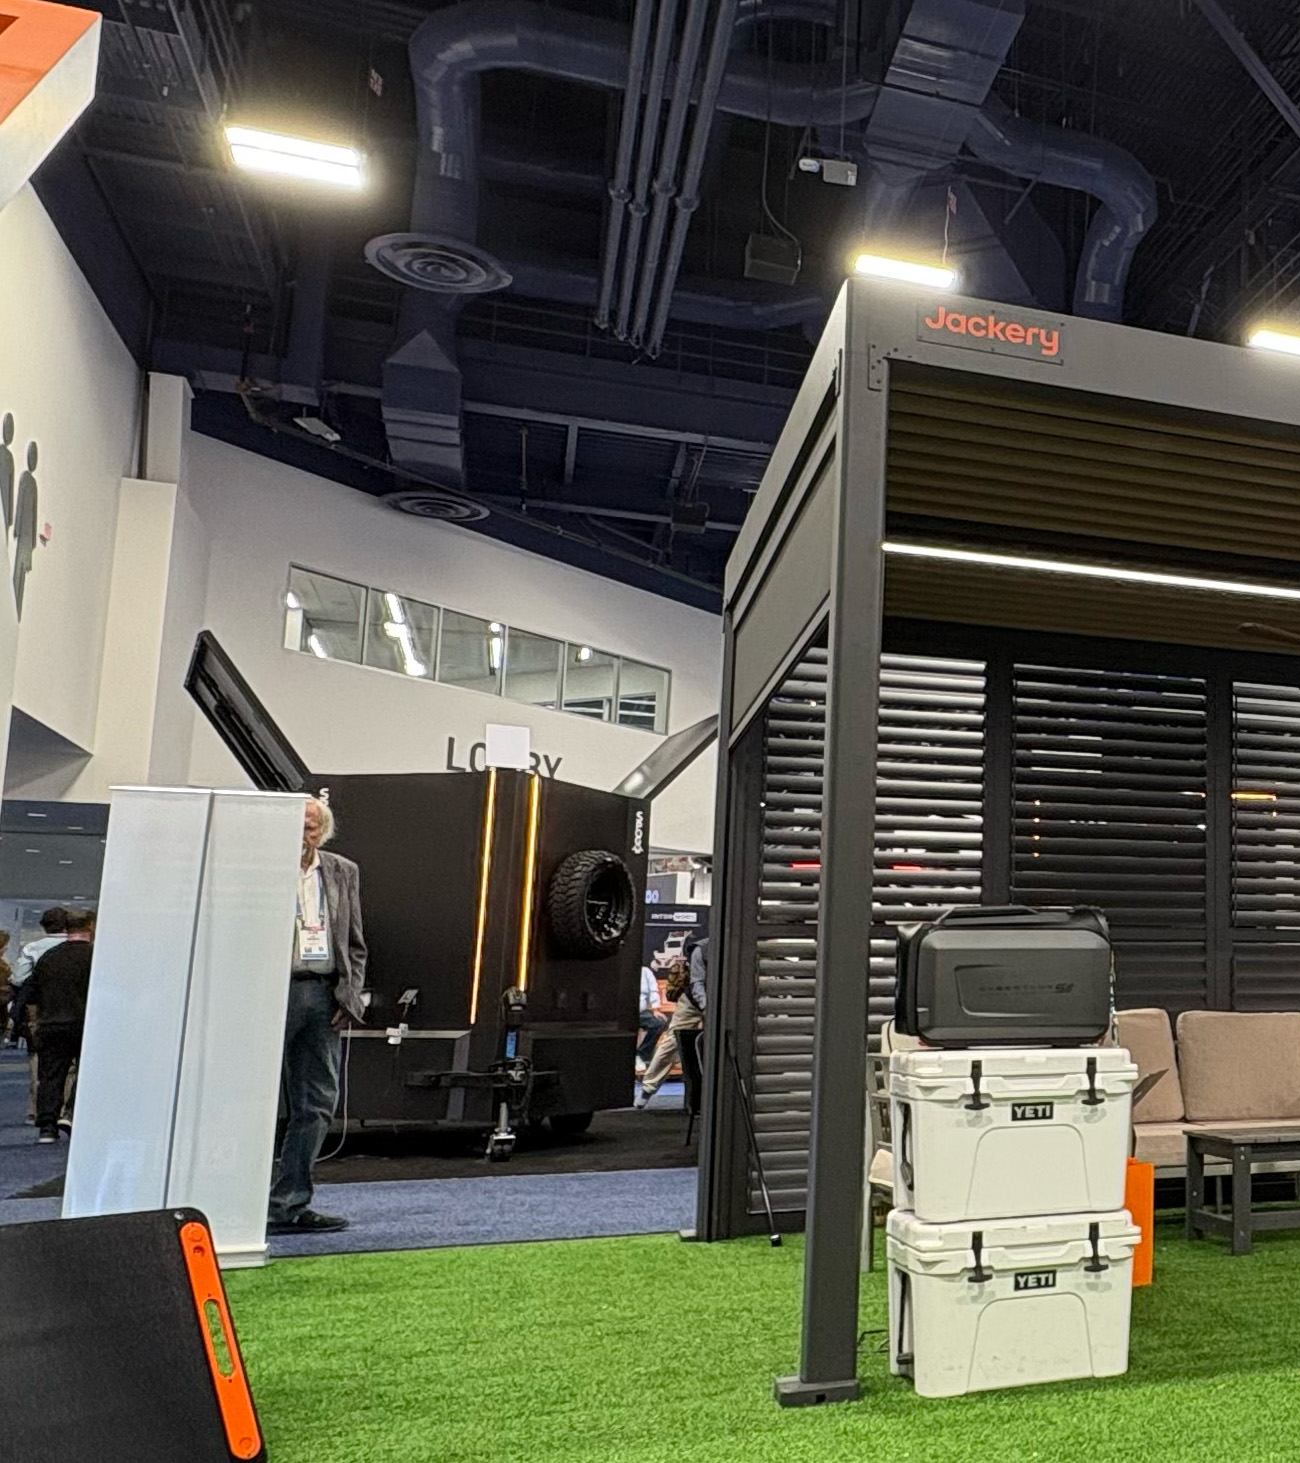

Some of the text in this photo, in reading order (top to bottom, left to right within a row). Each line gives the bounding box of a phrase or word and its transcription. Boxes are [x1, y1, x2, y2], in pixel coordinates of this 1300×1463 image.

[924, 305, 1060, 356] Jackery
[1013, 1103, 1052, 1119] YETI
[1016, 1272, 1055, 1288] YETI
